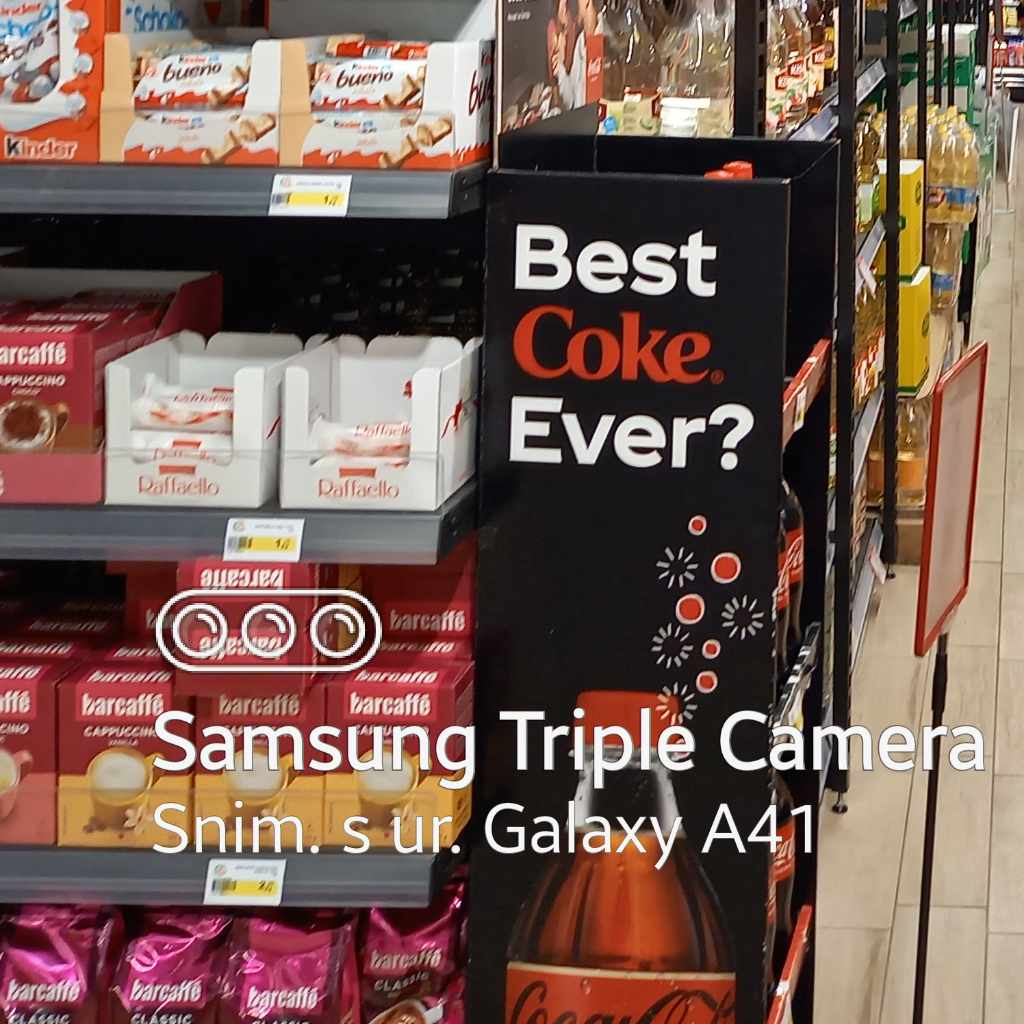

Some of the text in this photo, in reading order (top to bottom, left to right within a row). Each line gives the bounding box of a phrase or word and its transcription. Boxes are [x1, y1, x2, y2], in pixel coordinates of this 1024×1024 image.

[163, 63, 223, 83] bueno
[336, 69, 394, 89] bueno
[514, 224, 717, 298] Best
[512, 304, 713, 384] Coke
[509, 396, 755, 470] Ever?
[138, 476, 220, 496] Raffaello
[318, 479, 400, 498] Raffaello
